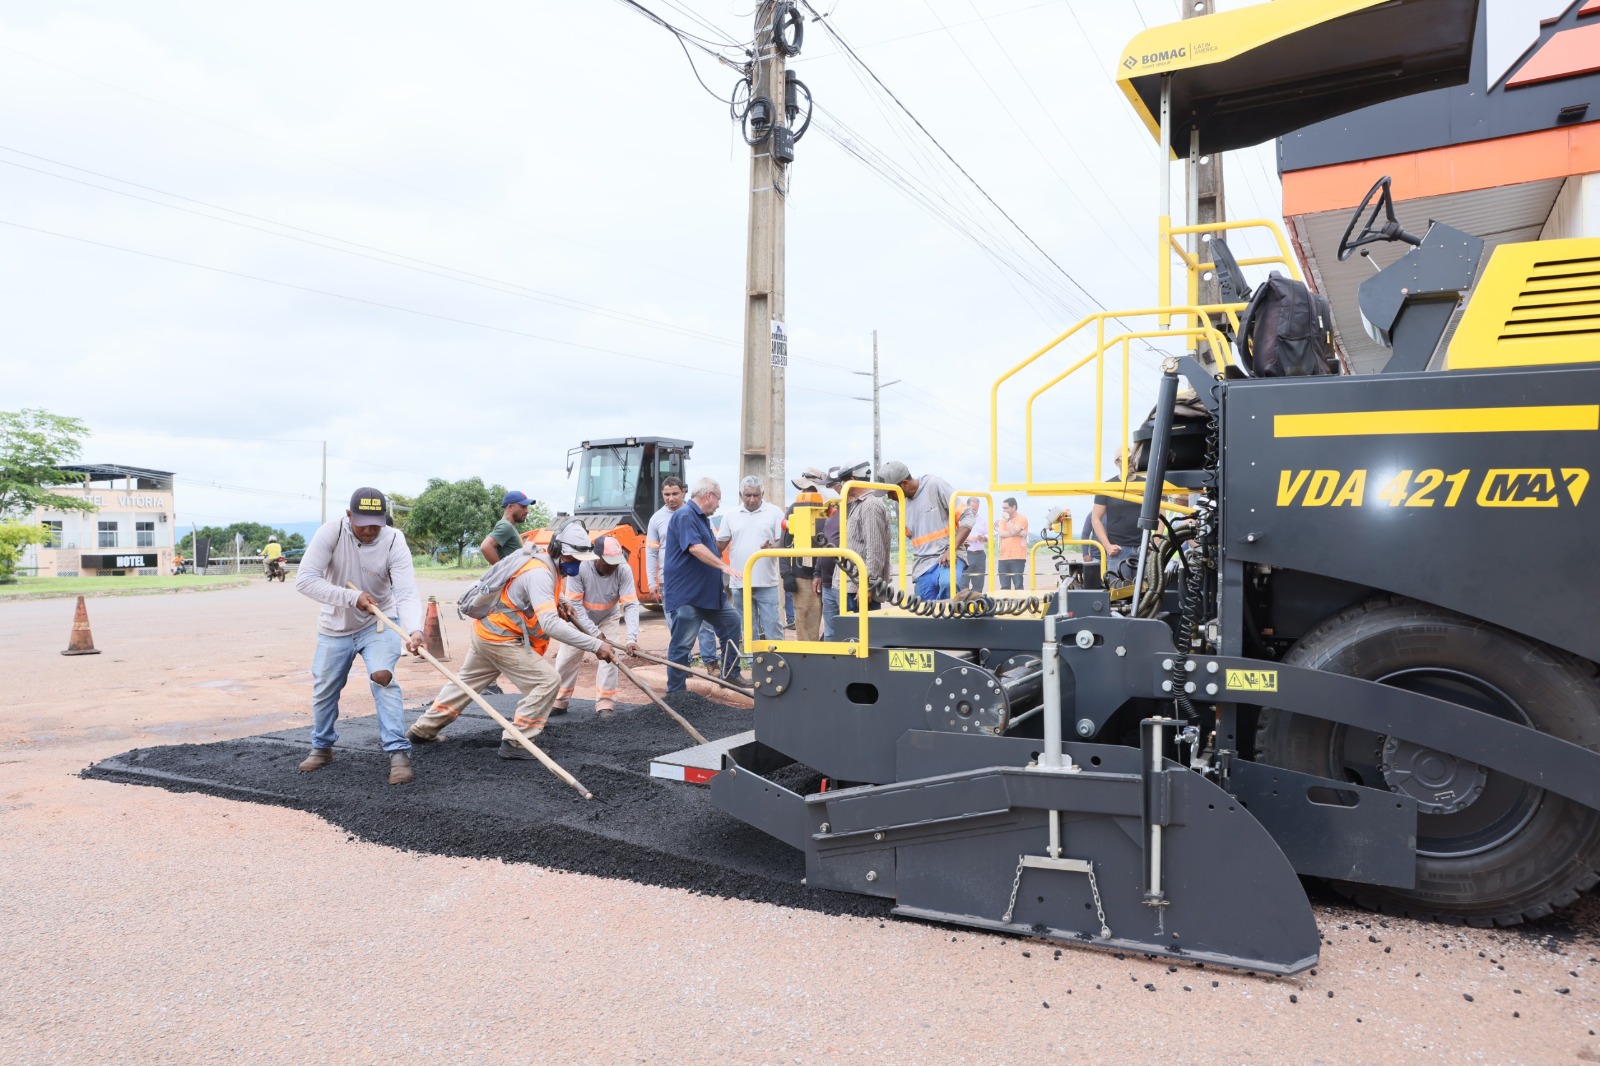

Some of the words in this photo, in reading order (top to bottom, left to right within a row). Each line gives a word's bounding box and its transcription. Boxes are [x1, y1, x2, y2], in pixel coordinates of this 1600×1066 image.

[1193, 42, 1211, 50] LATIN
[1194, 45, 1218, 55] AMERICA
[1141, 47, 1186, 64] BOMAG
[1276, 469, 1368, 507] VDA
[1377, 468, 1471, 508] 421
[1484, 468, 1585, 507] MAX
[116, 555, 145, 568] HOTEL
